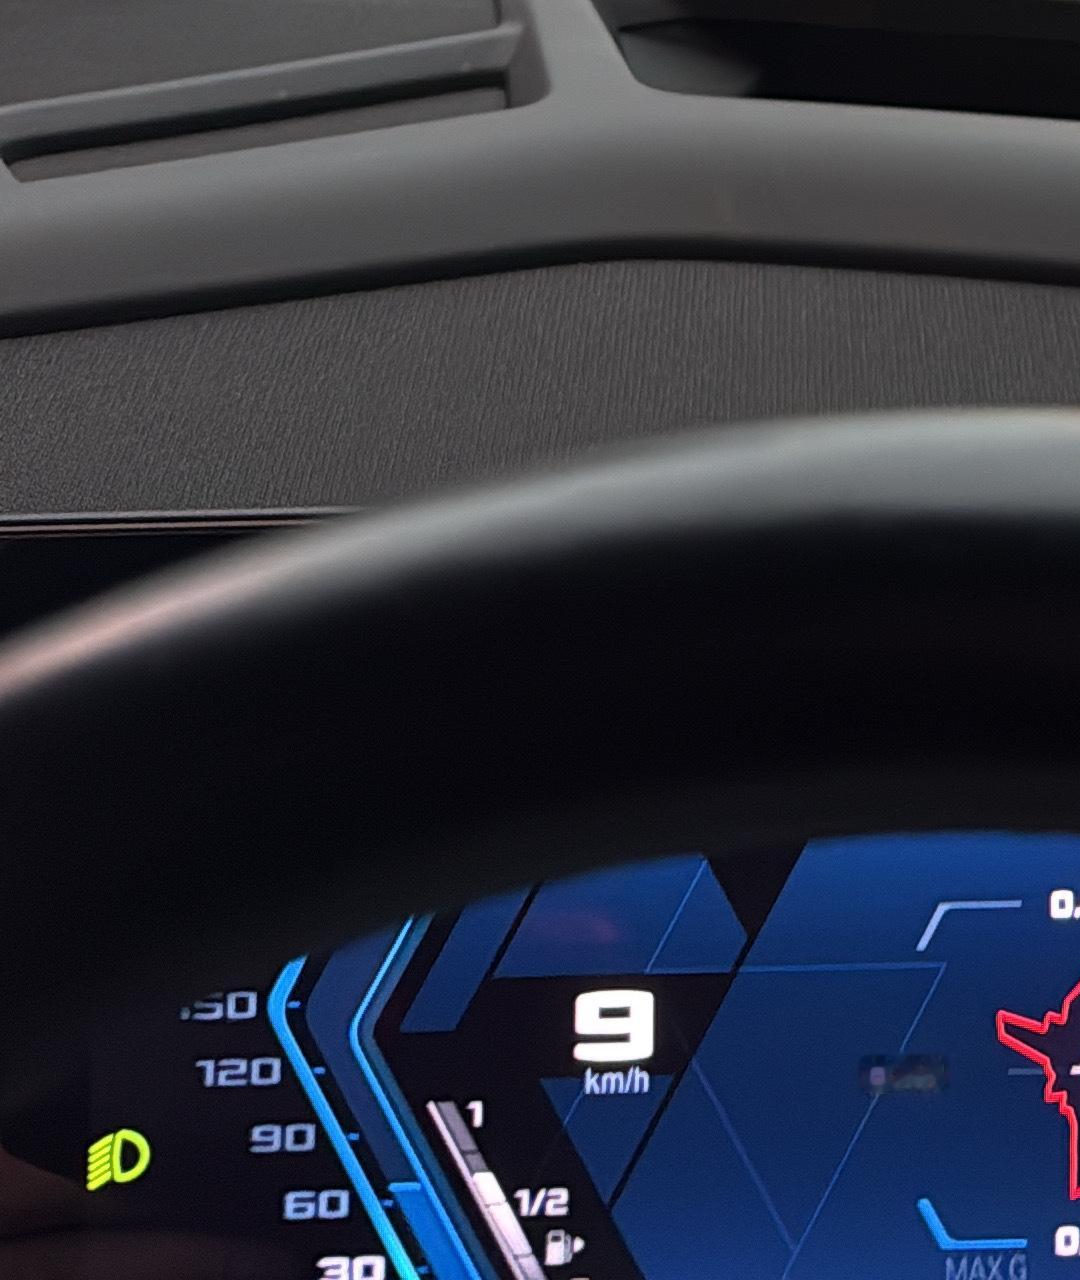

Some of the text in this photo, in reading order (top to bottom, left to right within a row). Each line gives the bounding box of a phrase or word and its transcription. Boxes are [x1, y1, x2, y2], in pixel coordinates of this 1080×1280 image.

[573, 989, 654, 1062] 9
[195, 1057, 282, 1087] 120
[584, 1066, 650, 1095] km/h
[466, 1100, 483, 1128] 1
[250, 1123, 317, 1153] 90
[283, 1189, 350, 1220] 60
[514, 1187, 569, 1217] 1/2
[316, 1255, 386, 1280] 30
[945, 1255, 1003, 1280] MAX
